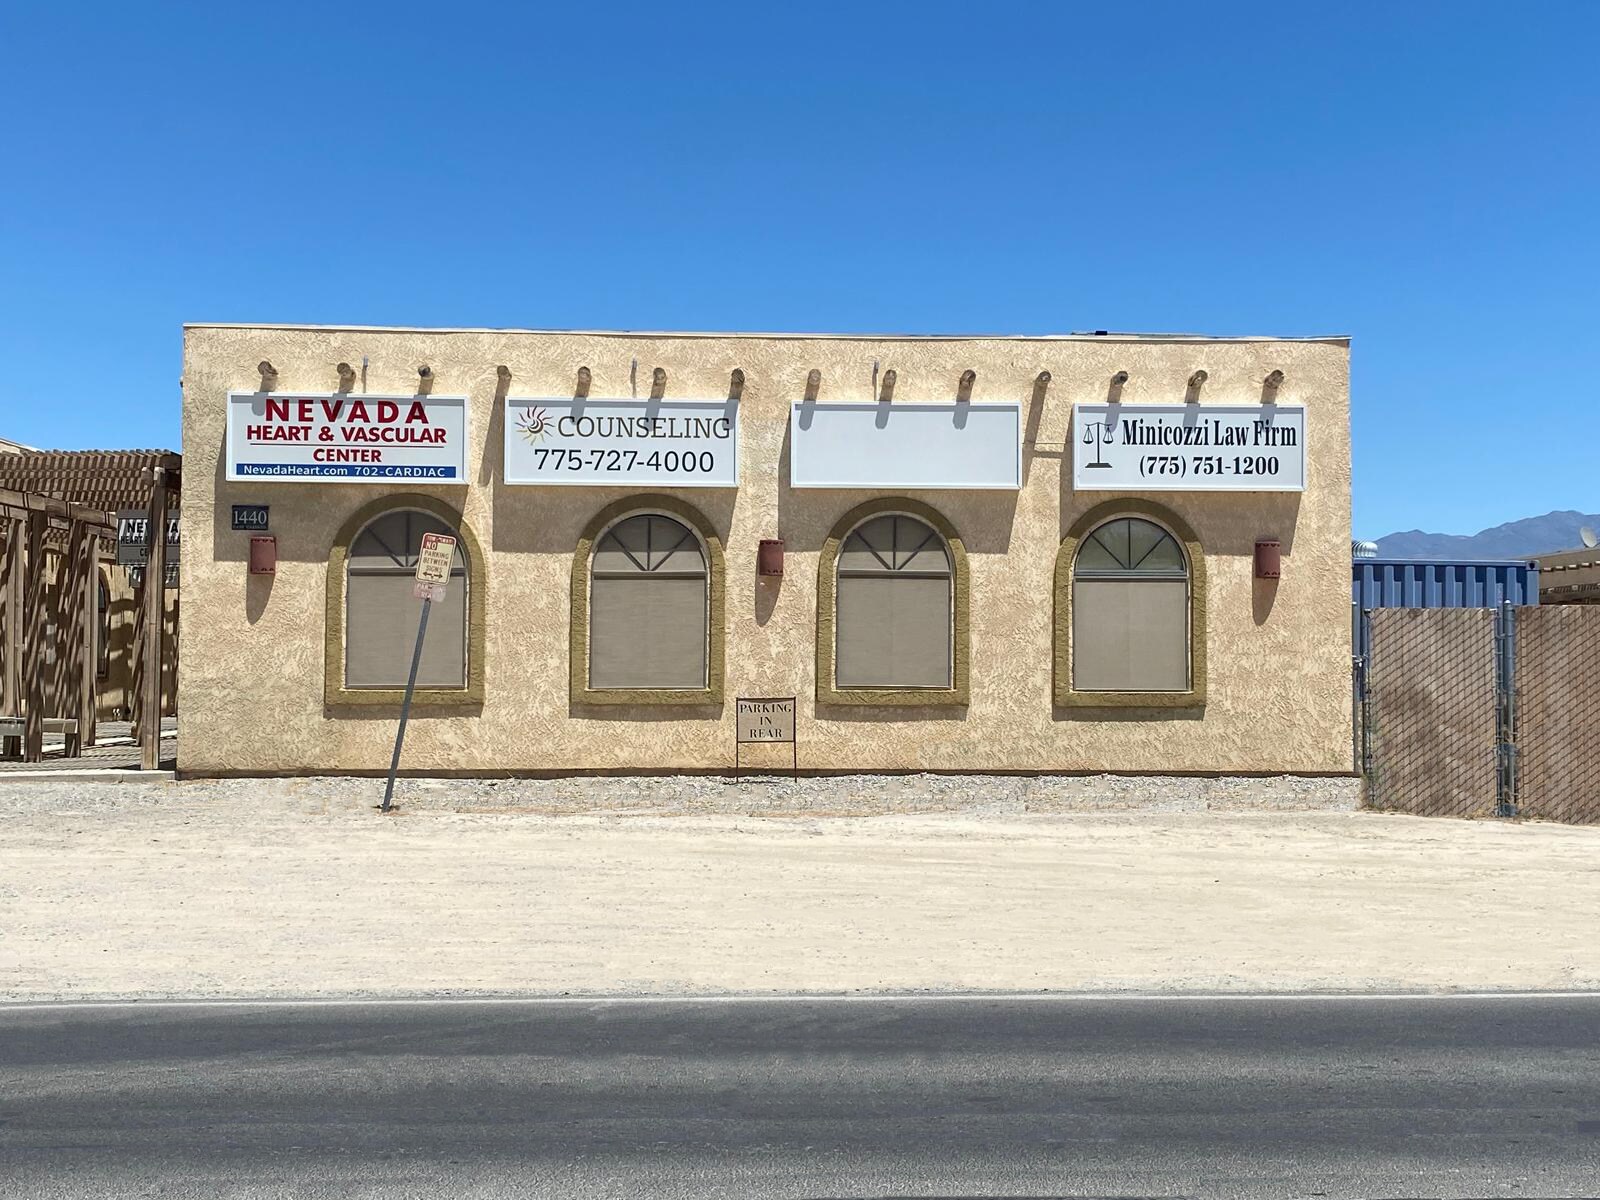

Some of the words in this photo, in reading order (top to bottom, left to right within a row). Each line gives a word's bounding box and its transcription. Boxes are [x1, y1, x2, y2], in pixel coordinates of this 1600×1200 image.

[265, 398, 430, 424] NEVADA
[246, 425, 312, 441] HEART
[318, 426, 334, 442] &
[341, 427, 447, 443] VASCULAR
[558, 416, 730, 439] COUNSELING
[1121, 418, 1209, 446] Minicozzi
[1213, 420, 1249, 446] Law
[1253, 419, 1297, 447] Firm
[312, 448, 382, 463] CENTER
[534, 448, 714, 472] 775-727-4000
[243, 464, 348, 476] NevadaHeart.com
[354, 466, 446, 477] 702-CARDIAC
[1139, 456, 1187, 478] (775)
[1193, 456, 1279, 475] 751-1200
[234, 510, 267, 525] 1440
[425, 541, 437, 550] NO
[423, 557, 448, 566] BETWEEN
[424, 550, 449, 559] PARKING
[740, 703, 791, 713] PARKING
[760, 716, 772, 725] IN
[750, 728, 782, 738] REAR
